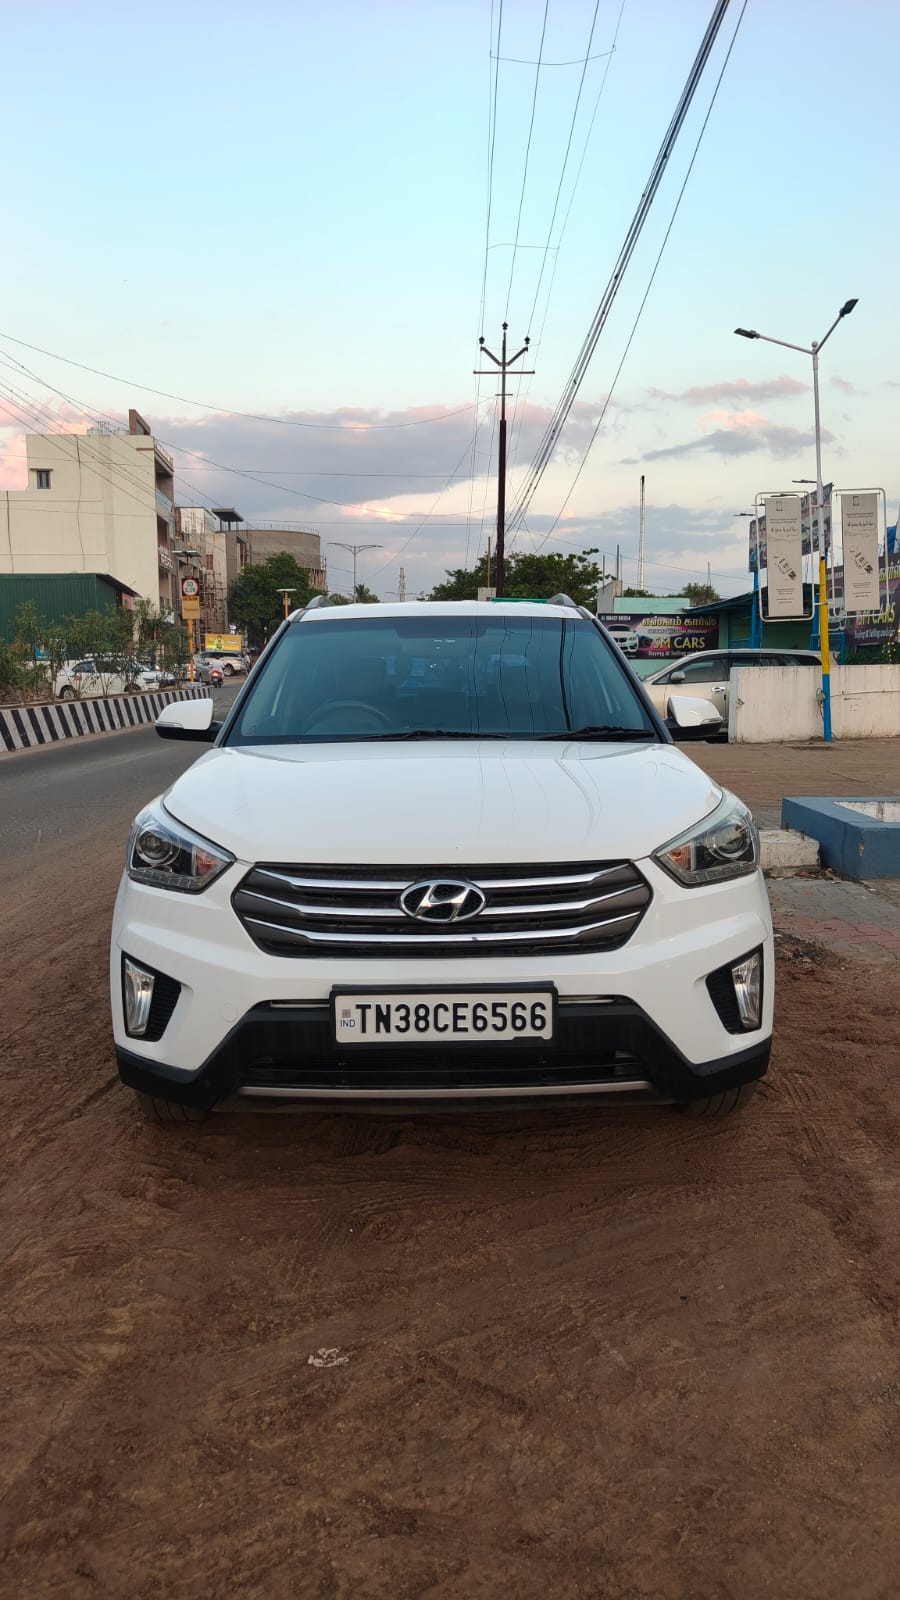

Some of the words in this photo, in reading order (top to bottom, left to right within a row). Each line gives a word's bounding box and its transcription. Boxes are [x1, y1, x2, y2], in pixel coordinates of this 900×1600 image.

[653, 638, 670, 648] SM
[674, 638, 705, 648] CARS
[355, 1001, 547, 1034] TN38CE6566
[340, 1019, 356, 1028] IND
